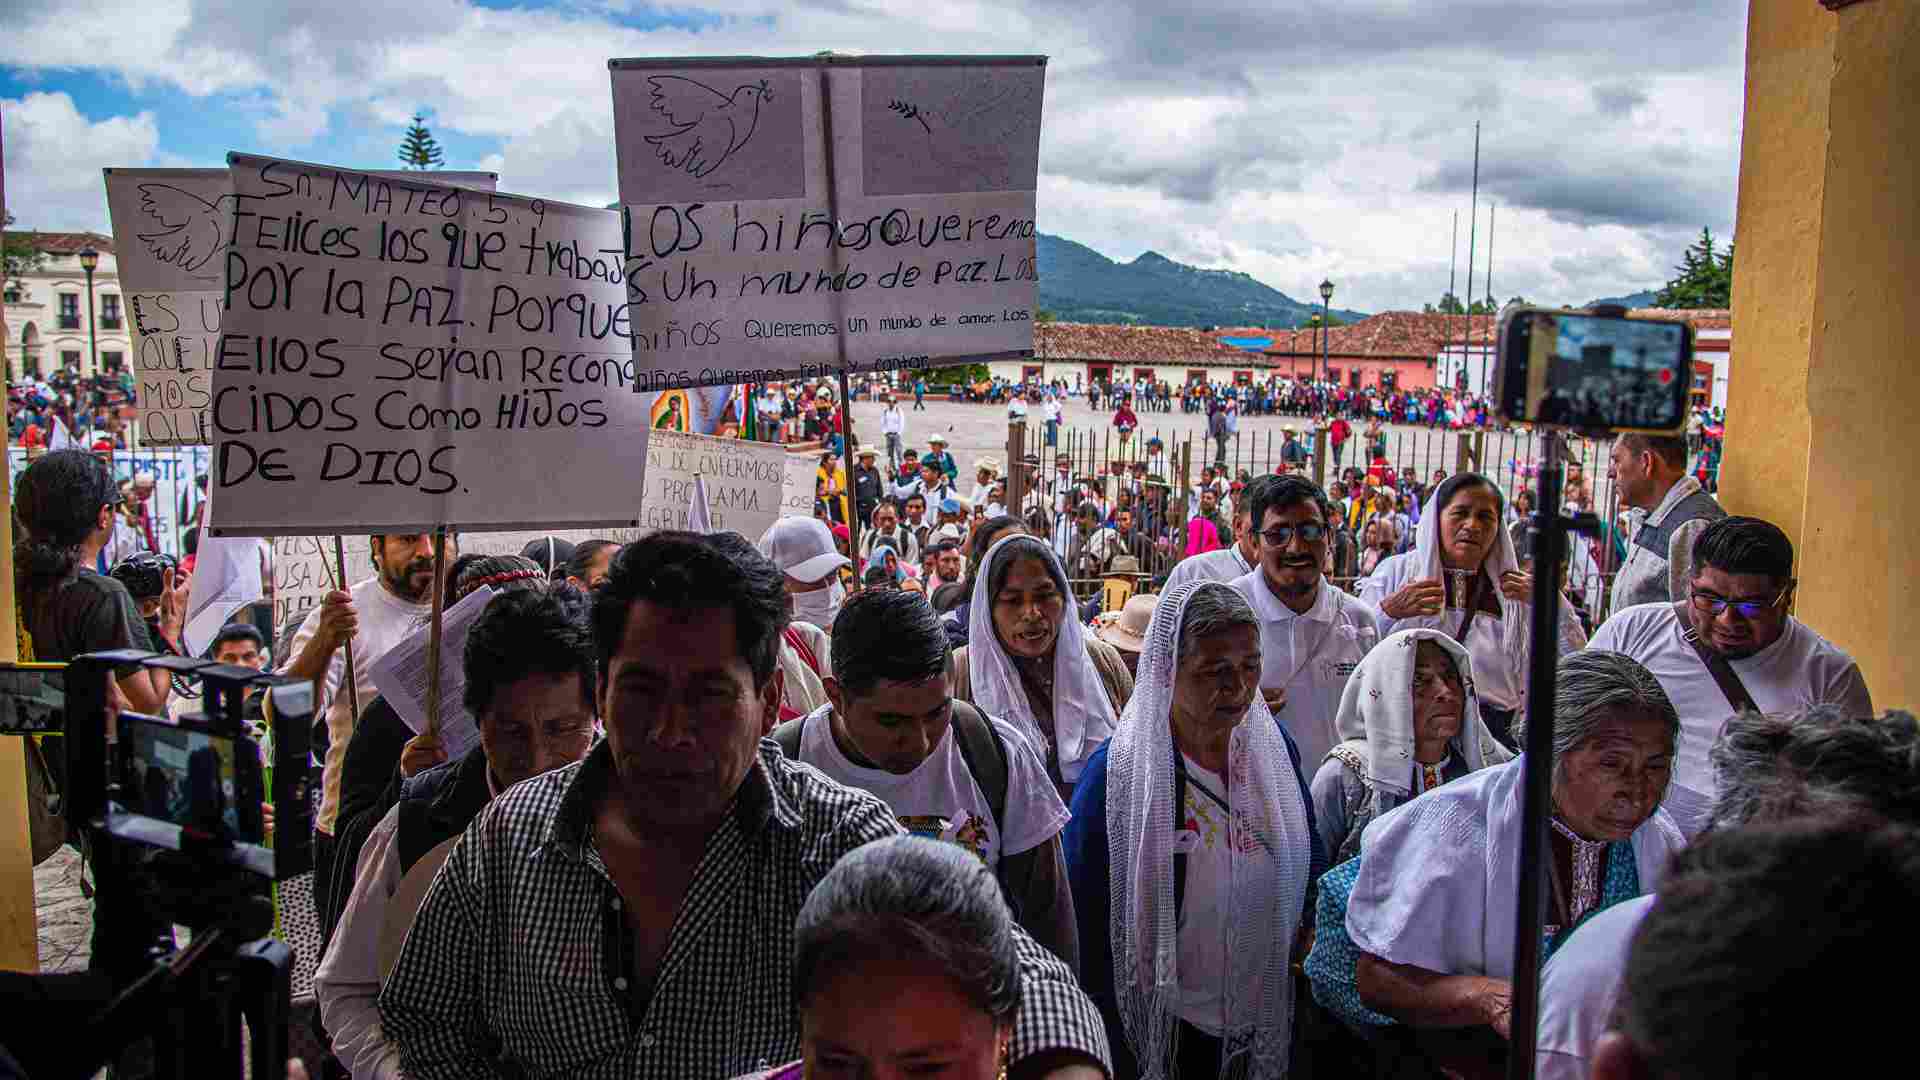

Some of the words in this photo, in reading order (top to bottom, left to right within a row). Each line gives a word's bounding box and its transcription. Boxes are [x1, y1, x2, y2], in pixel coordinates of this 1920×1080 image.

[878, 261, 921, 289] de
[879, 313, 922, 331] mundo
[929, 313, 946, 328] de
